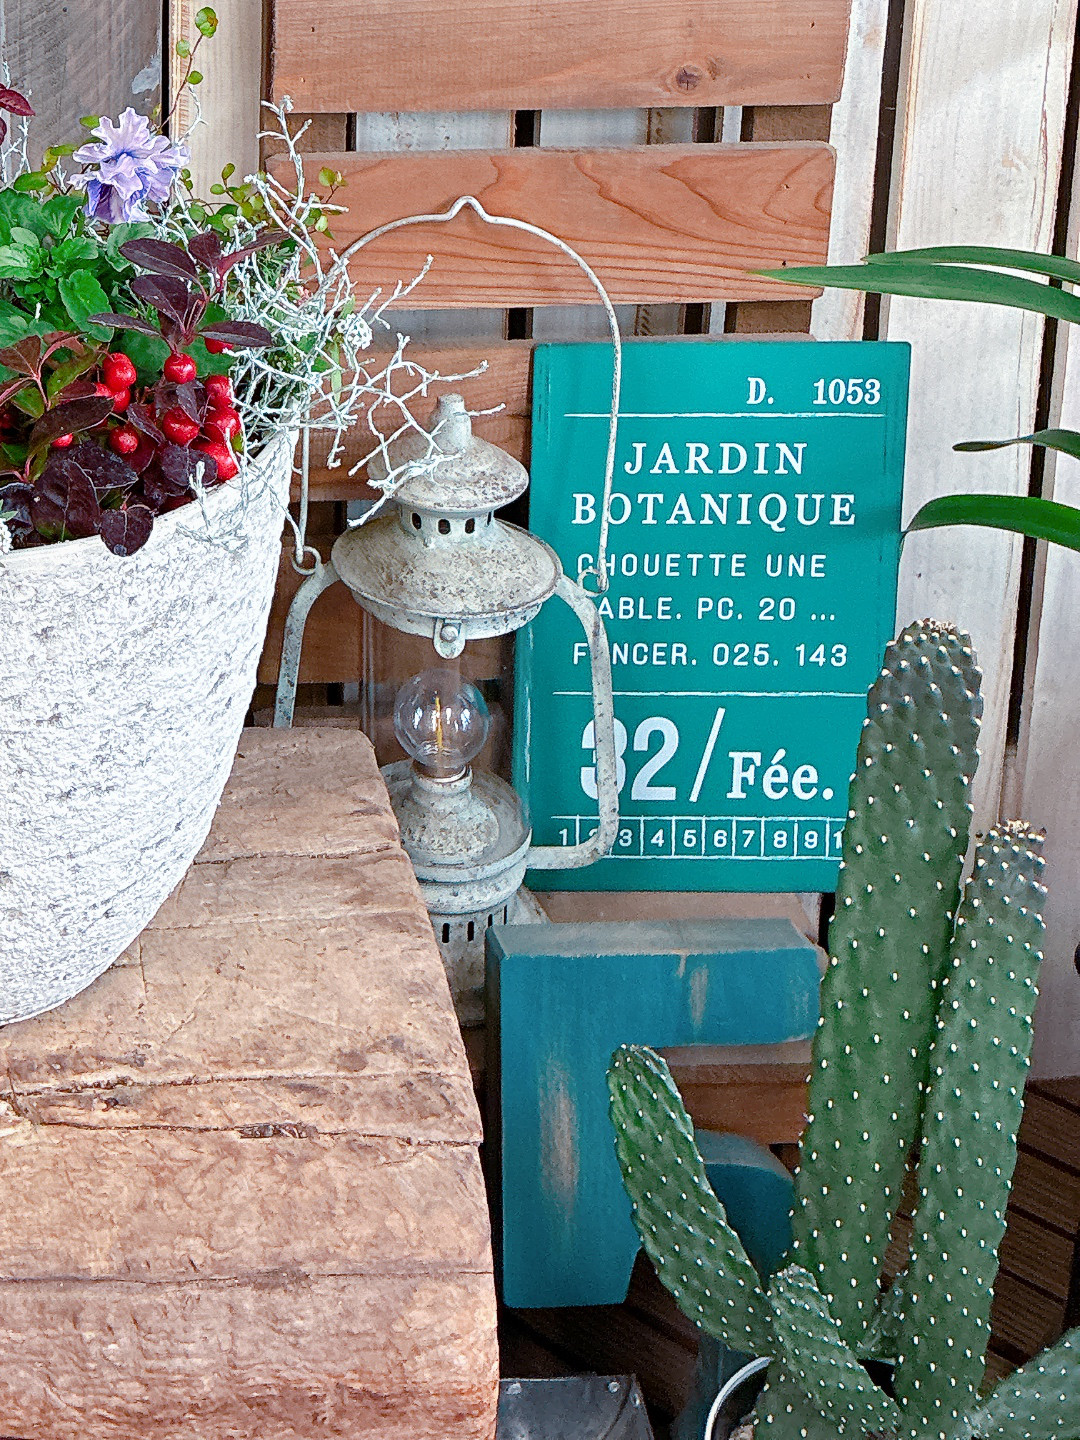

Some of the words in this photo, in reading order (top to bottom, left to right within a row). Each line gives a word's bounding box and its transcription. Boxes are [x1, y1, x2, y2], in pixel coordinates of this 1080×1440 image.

[746, 376, 775, 405] D.
[812, 377, 882, 405] 1053
[623, 441, 808, 475] JARDIN
[571, 492, 857, 533] BOTANIQUE
[576, 552, 747, 578] CHOUETTE
[765, 553, 827, 578] UNE
[696, 596, 744, 620] PC.
[758, 596, 796, 621] 20
[572, 642, 698, 666] FNCER.
[712, 642, 779, 667] 025.
[795, 643, 848, 667] 143
[558, 828, 568, 846] 1
[618, 828, 633, 847] 3
[650, 828, 665, 847] 4
[683, 829, 697, 848] 5
[713, 829, 728, 848] 6
[741, 829, 756, 848] 7
[772, 830, 787, 849] 8
[804, 830, 819, 849] 9
